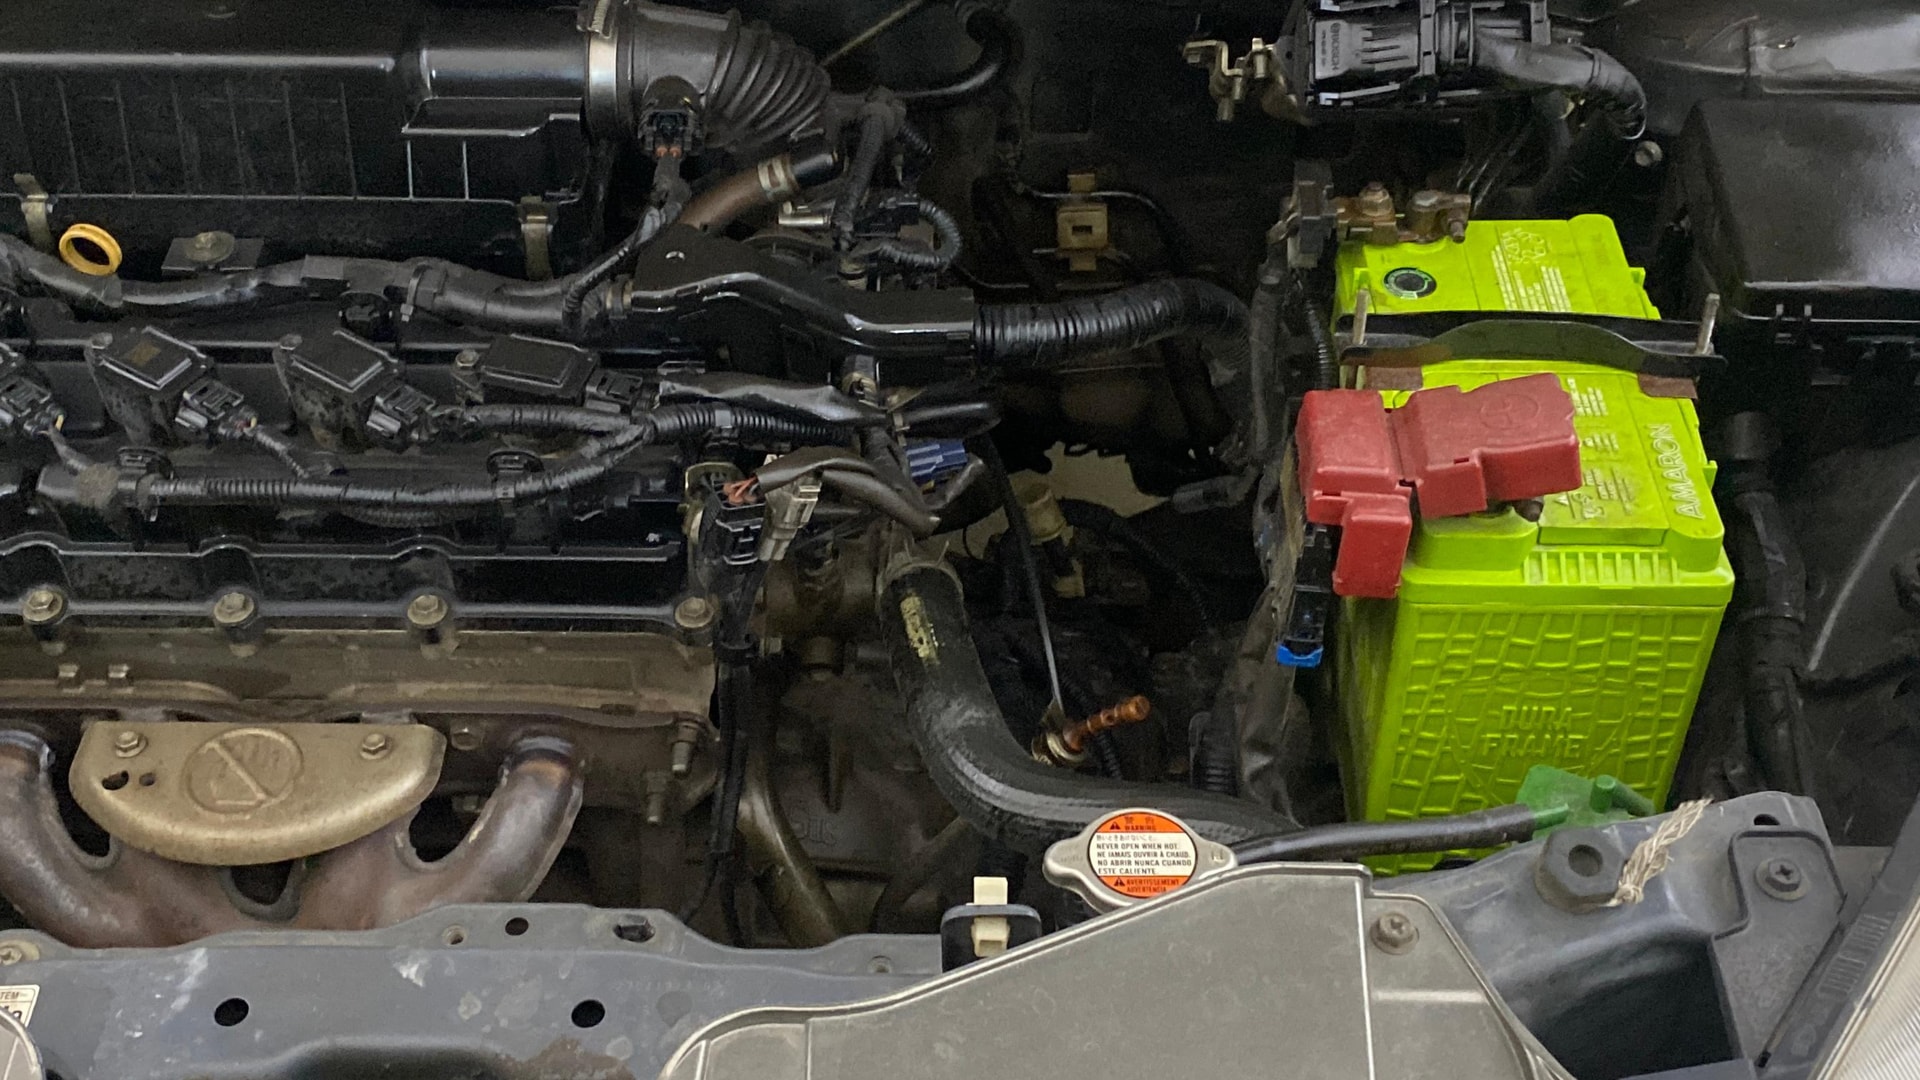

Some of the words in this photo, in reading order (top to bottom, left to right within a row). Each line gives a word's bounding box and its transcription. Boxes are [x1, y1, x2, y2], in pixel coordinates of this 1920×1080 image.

[1651, 424, 1705, 518] AMARON
[1500, 706, 1572, 730] DURA
[1482, 734, 1585, 758] FRAME
